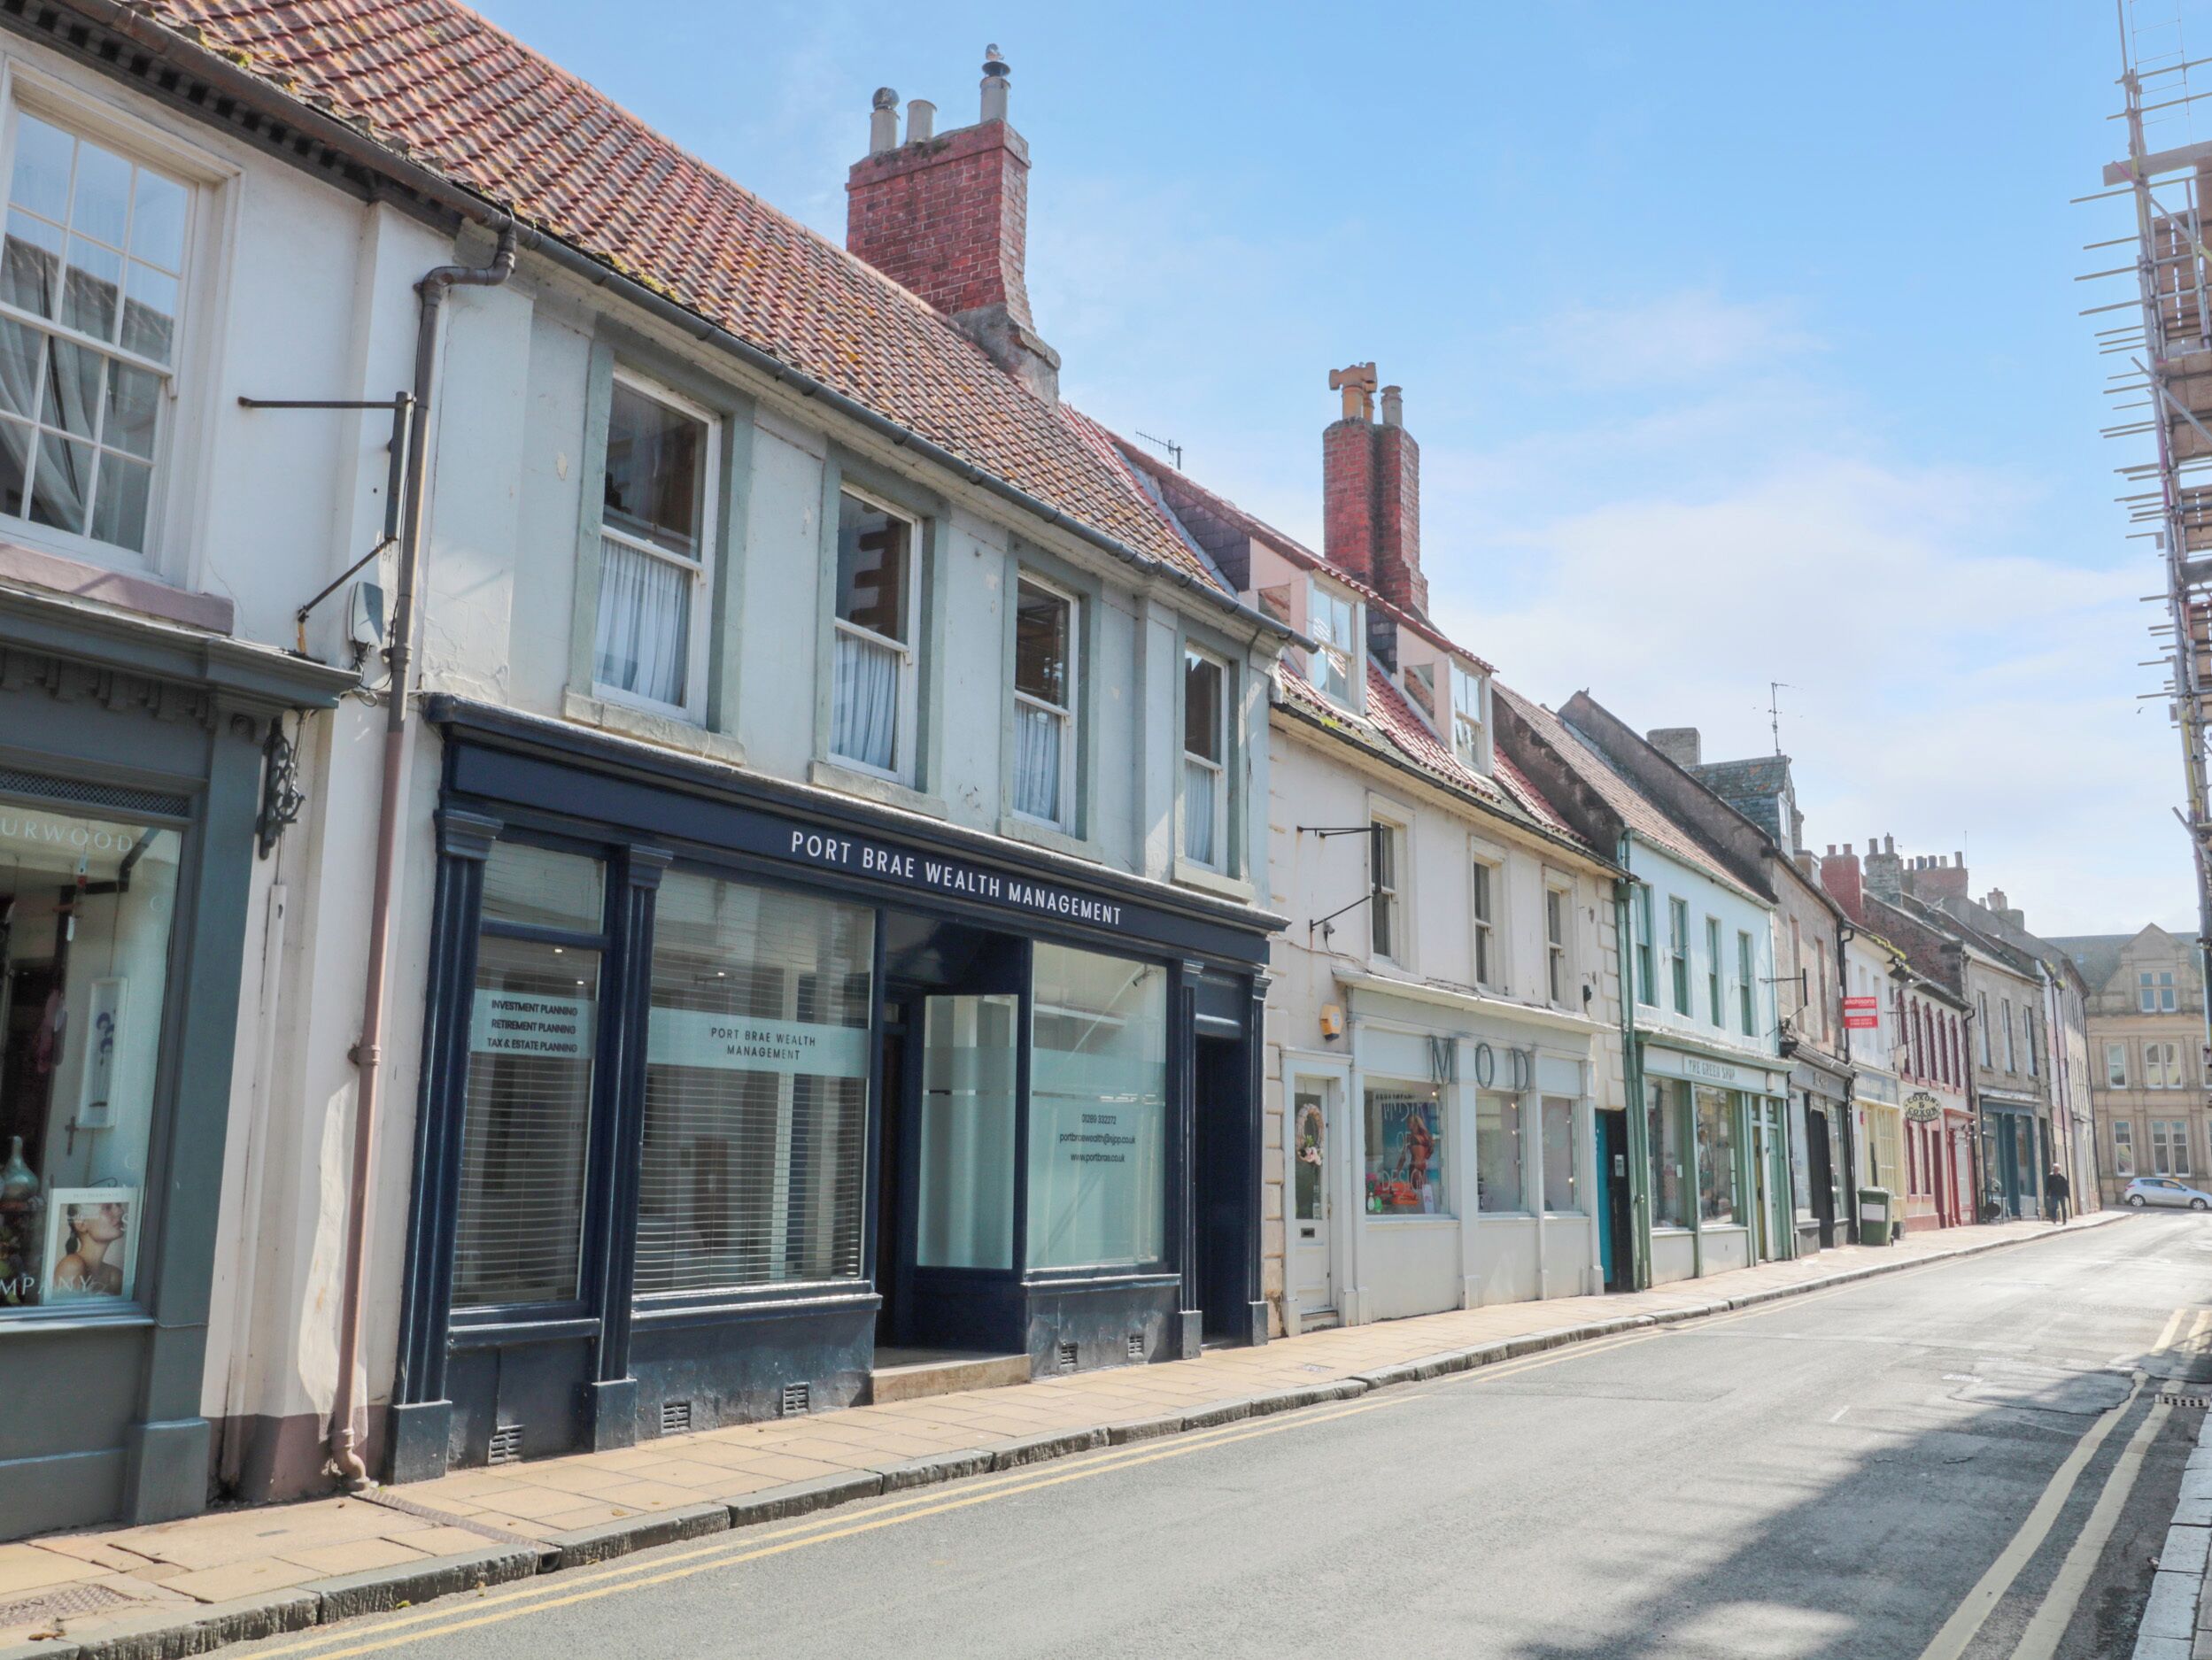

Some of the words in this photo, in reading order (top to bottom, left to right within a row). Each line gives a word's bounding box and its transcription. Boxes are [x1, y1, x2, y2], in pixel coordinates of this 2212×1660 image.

[791, 831, 851, 863] PORT
[863, 847, 915, 878] BRAE
[925, 861, 1001, 897] WEALTH
[1009, 883, 1122, 926] MANAGEMENT
[491, 1000, 539, 1013] INVESTMENT
[540, 1005, 578, 1016] PLANNING
[491, 1019, 537, 1031] RETIREMENT
[538, 1023, 576, 1035] PLANNING
[711, 1027, 739, 1039] PORT
[745, 1031, 771, 1043] BRAE
[777, 1033, 816, 1046] WEALTH
[487, 1038, 503, 1048] TAX
[504, 1038, 509, 1048] &
[512, 1039, 538, 1050] ESTATE
[540, 1041, 578, 1053] PLANNING
[727, 1045, 800, 1061] MANAGEMENT
[1430, 1035, 1531, 1092] MOD
[1689, 1060, 1700, 1074] THE
[1702, 1062, 1721, 1078] GREEN
[1906, 1094, 1937, 1104] COXON
[1908, 1106, 1937, 1116] COXON
